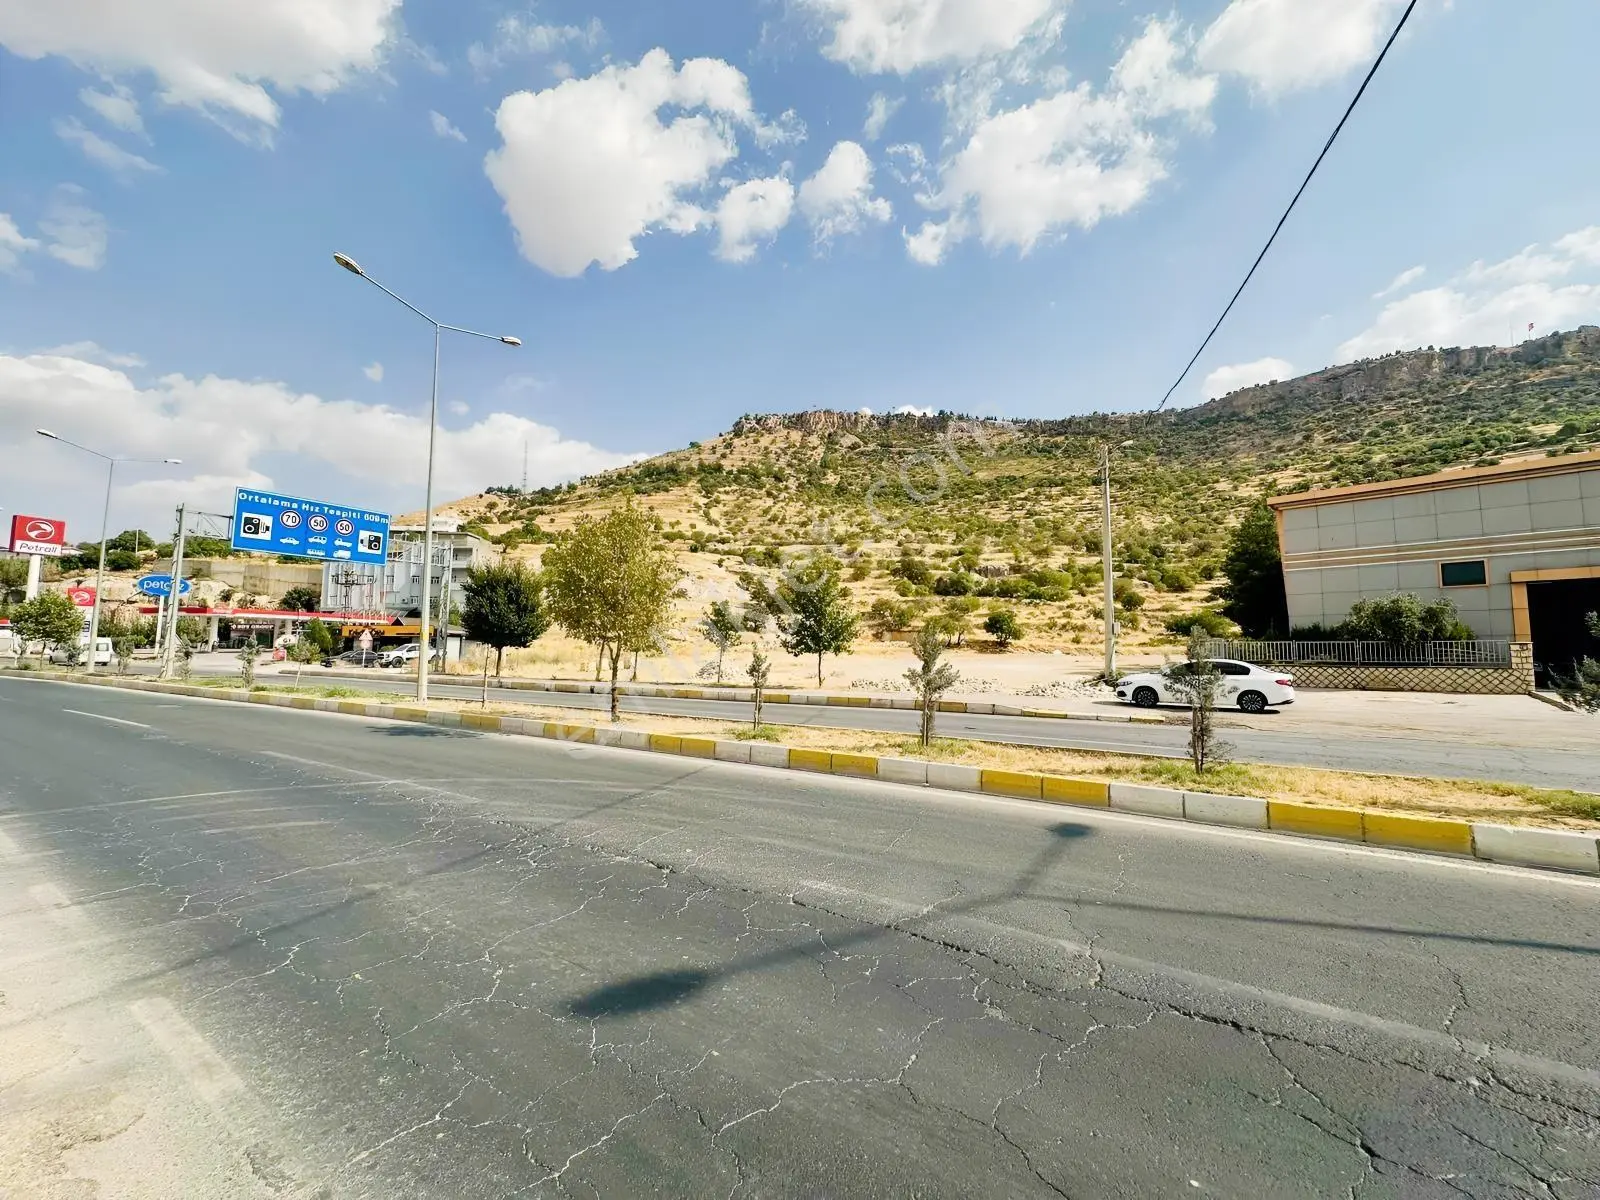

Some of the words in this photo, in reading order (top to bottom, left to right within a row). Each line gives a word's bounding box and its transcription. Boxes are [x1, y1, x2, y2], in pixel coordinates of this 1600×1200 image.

[238, 492, 298, 509] Ortalama
[323, 506, 360, 519] Tespiti
[285, 514, 297, 524] 70
[313, 519, 324, 527] 50
[339, 523, 350, 532] 50
